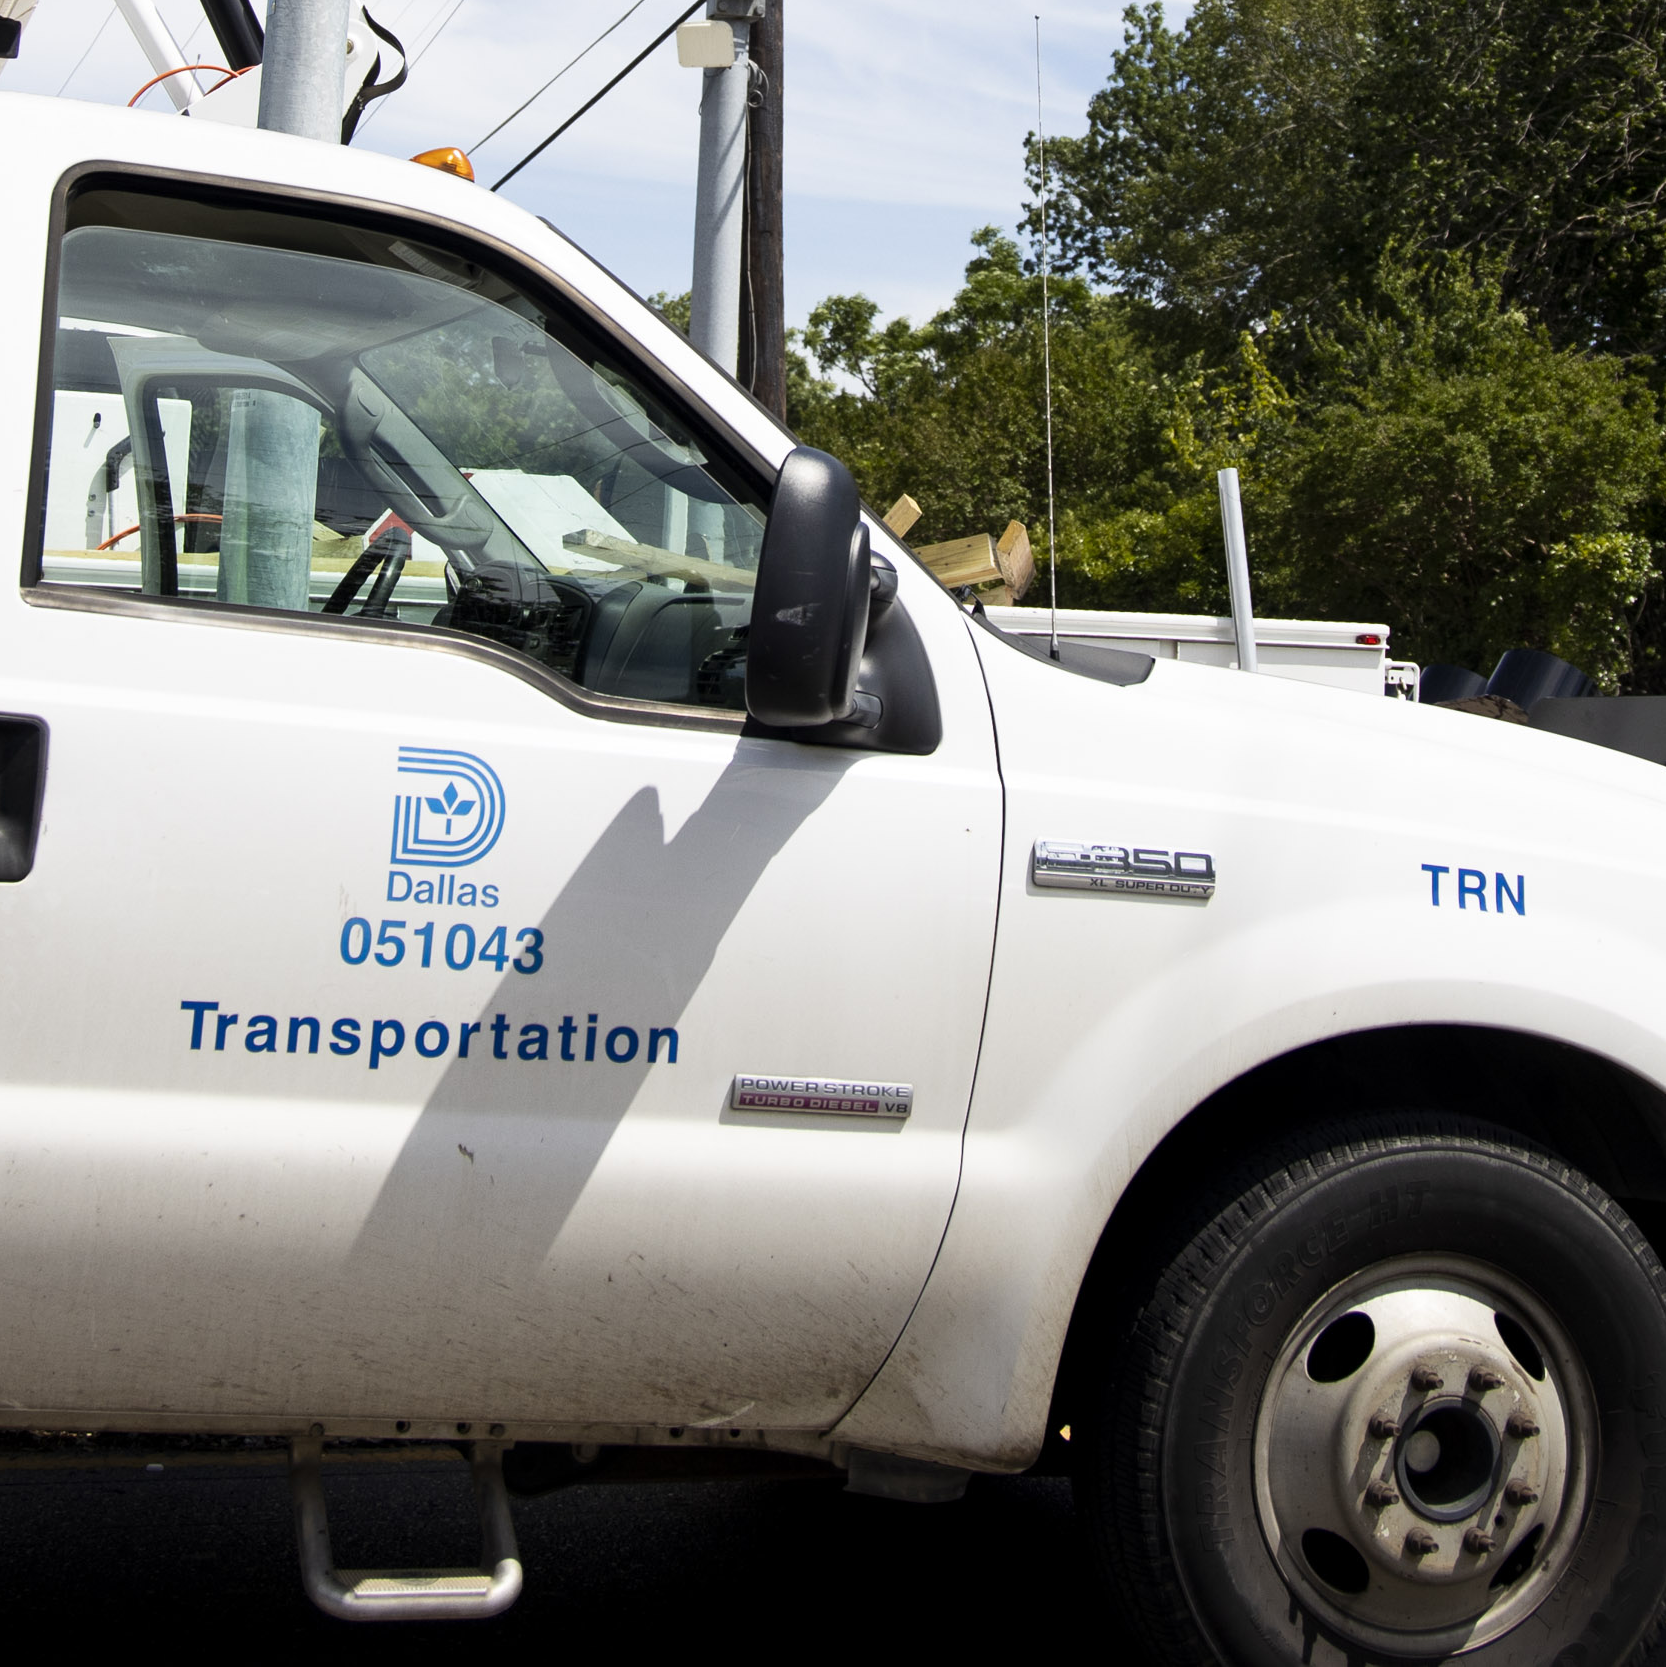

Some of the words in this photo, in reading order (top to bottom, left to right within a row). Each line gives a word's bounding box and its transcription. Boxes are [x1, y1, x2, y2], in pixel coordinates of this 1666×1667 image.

[386, 870, 500, 908] Dallas
[1089, 877, 1108, 888] XL
[1115, 879, 1165, 892] SUPER
[1169, 884, 1210, 895] DUTY
[1421, 863, 1526, 916] TRN
[340, 916, 544, 975] 051043
[180, 1000, 680, 1070] Transportation
[740, 1078, 819, 1093] POWER
[824, 1082, 910, 1098] STROKE
[743, 1094, 805, 1108] TURBO
[809, 1098, 876, 1112] DIESEL
[884, 1102, 908, 1113] V8
[1193, 1204, 1351, 1553] TRANSFORCE
[1369, 1180, 1431, 1231] HT
